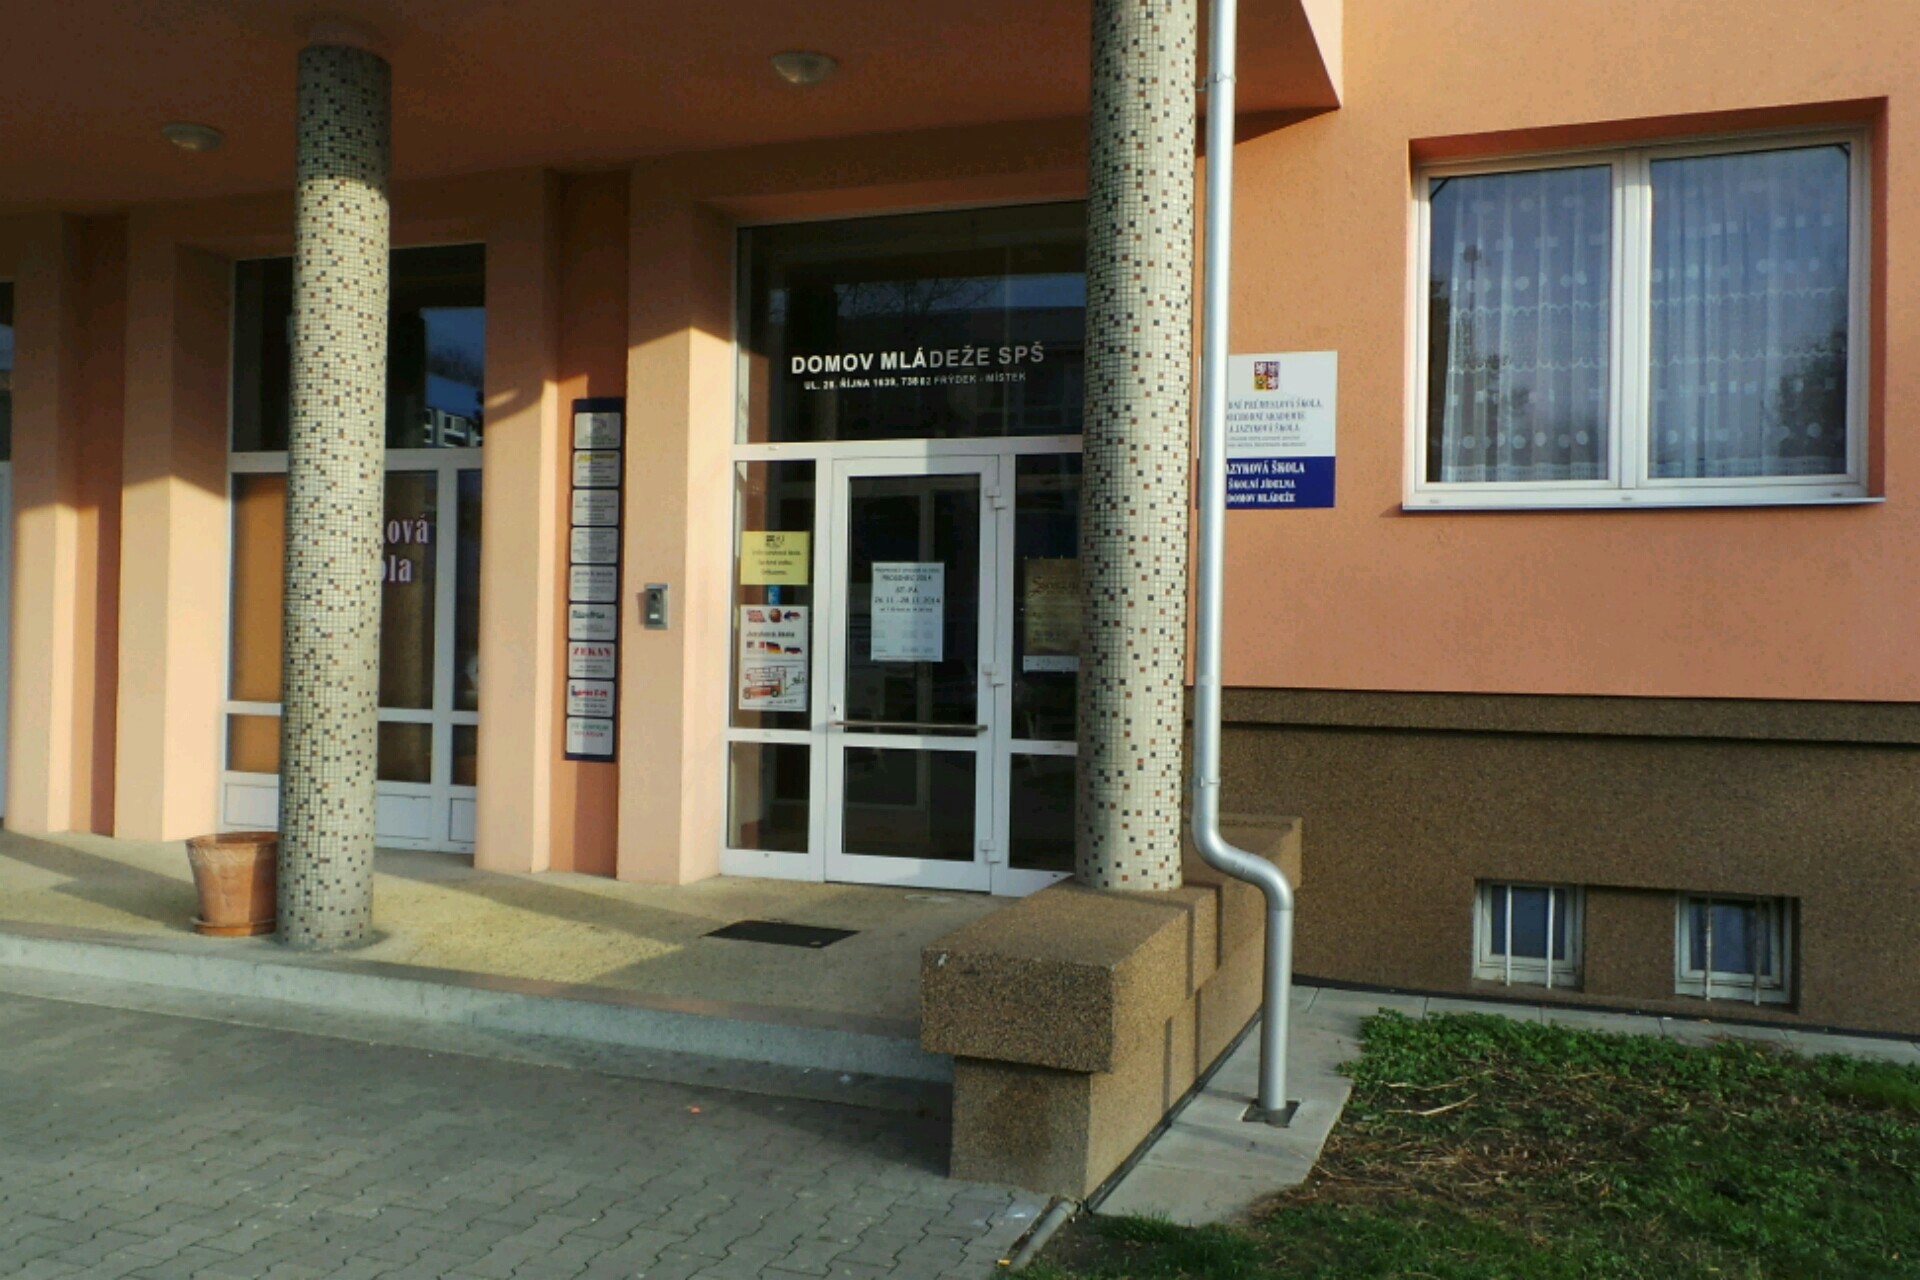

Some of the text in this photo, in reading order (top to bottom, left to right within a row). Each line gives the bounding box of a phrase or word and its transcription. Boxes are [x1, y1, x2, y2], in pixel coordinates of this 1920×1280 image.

[791, 342, 1044, 374] DOMOV MLÁDEŽE SPŠ
[1271, 460, 1305, 474] ŠKOLA
